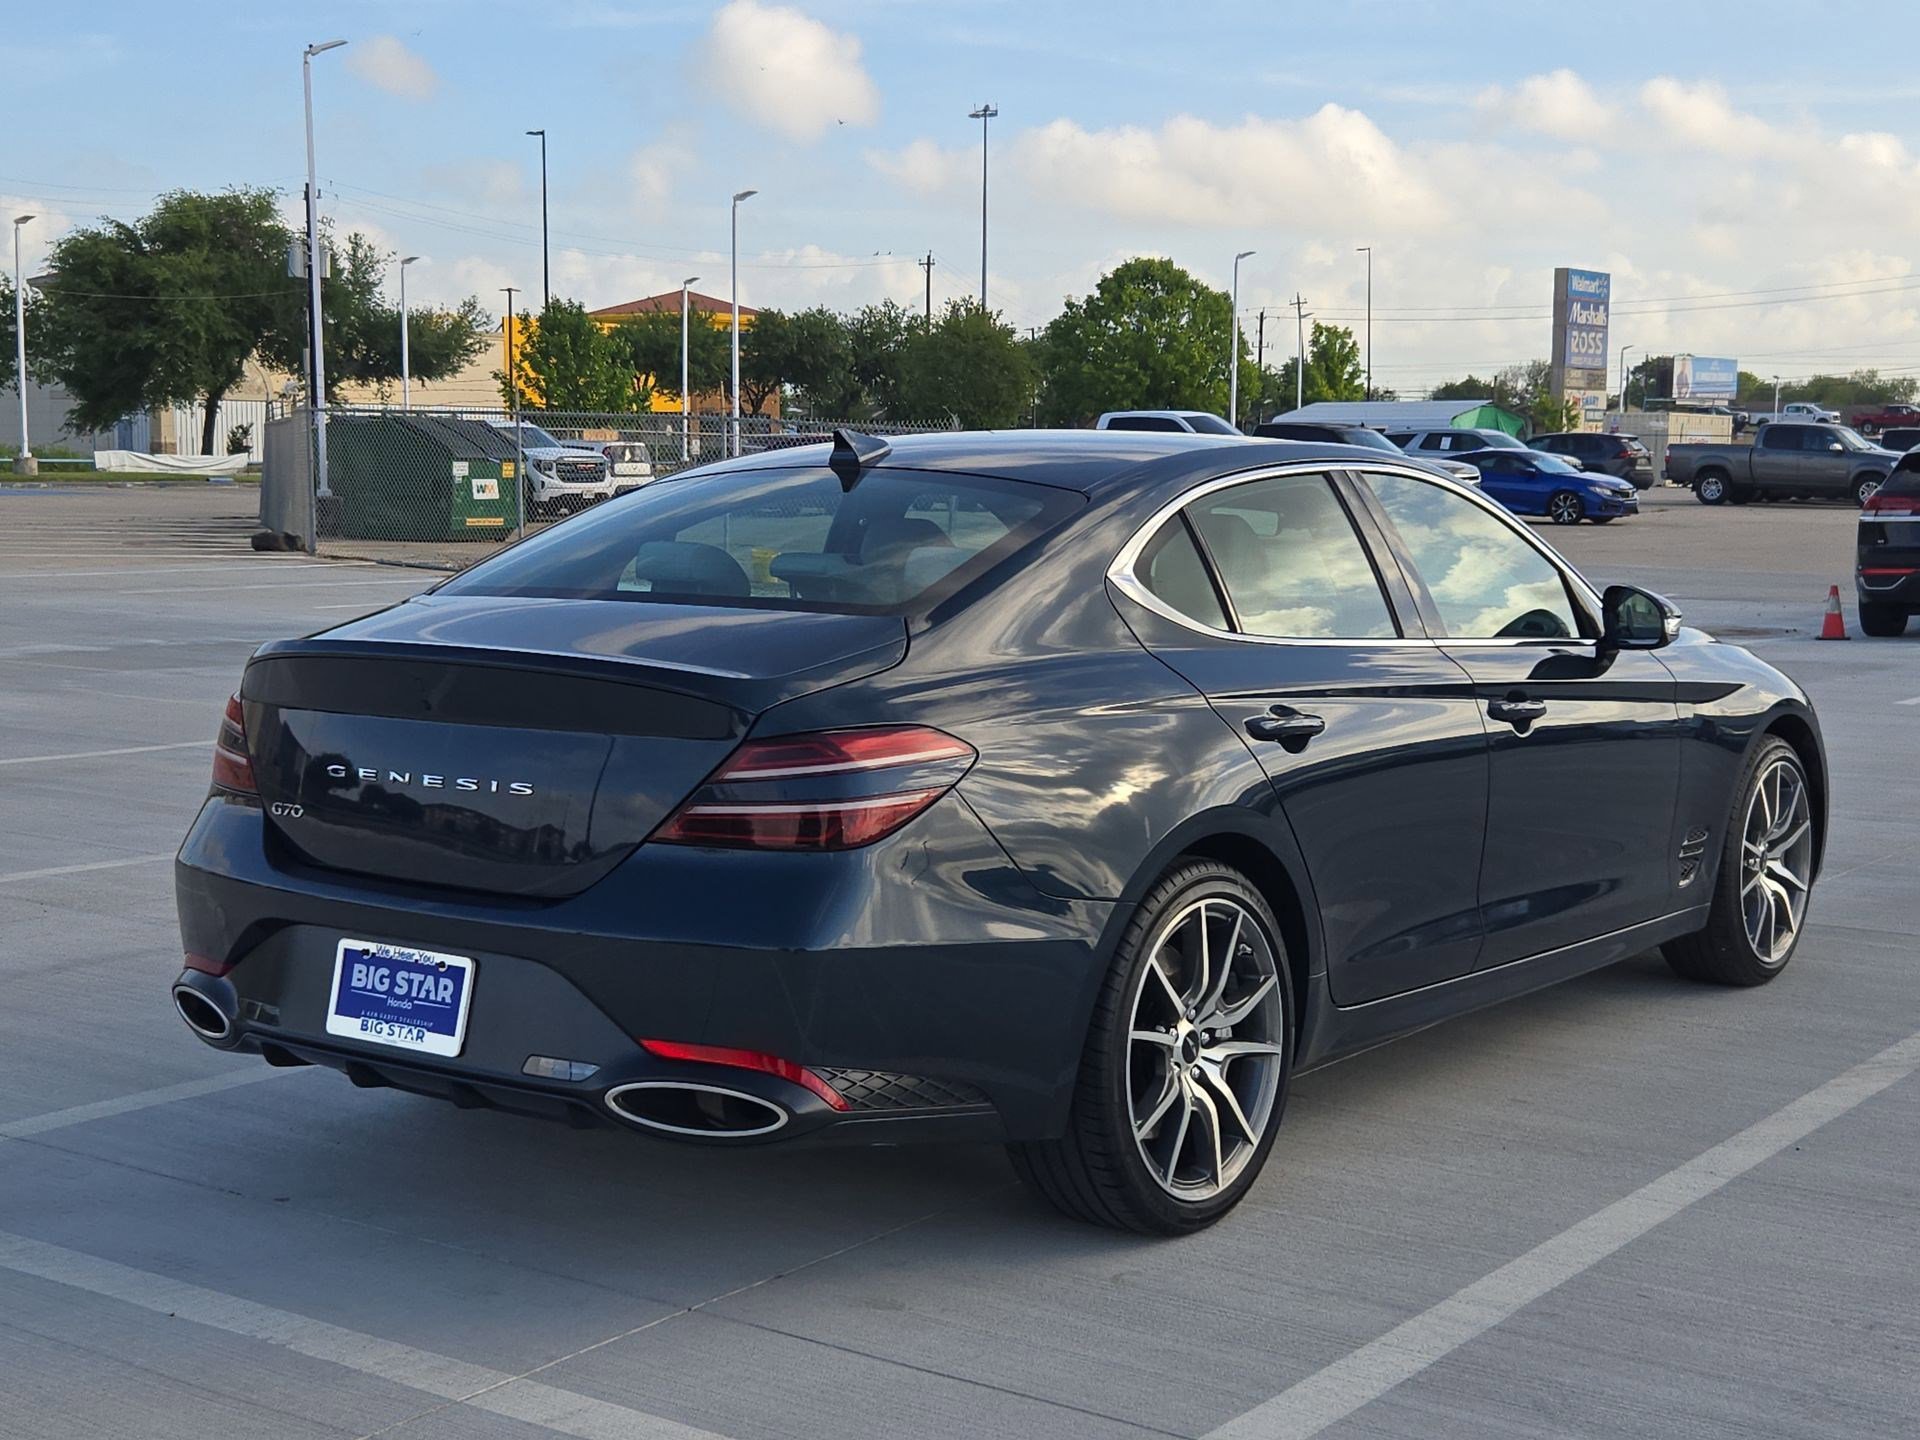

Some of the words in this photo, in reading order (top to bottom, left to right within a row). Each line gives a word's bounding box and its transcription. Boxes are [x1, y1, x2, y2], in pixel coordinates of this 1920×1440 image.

[1571, 274, 1600, 294] Walmart
[1569, 301, 1607, 326] Marshalls
[1571, 331, 1604, 355] ROSS
[326, 764, 535, 796] GENESIS
[271, 801, 304, 819] G70
[375, 944, 391, 959] We
[393, 947, 415, 961] Hear
[417, 951, 436, 965] You
[351, 963, 391, 992] BIG
[394, 970, 454, 1003] STAR
[387, 996, 413, 1010] Honda
[360, 1019, 384, 1034] BIG
[387, 1024, 425, 1043] STAR
